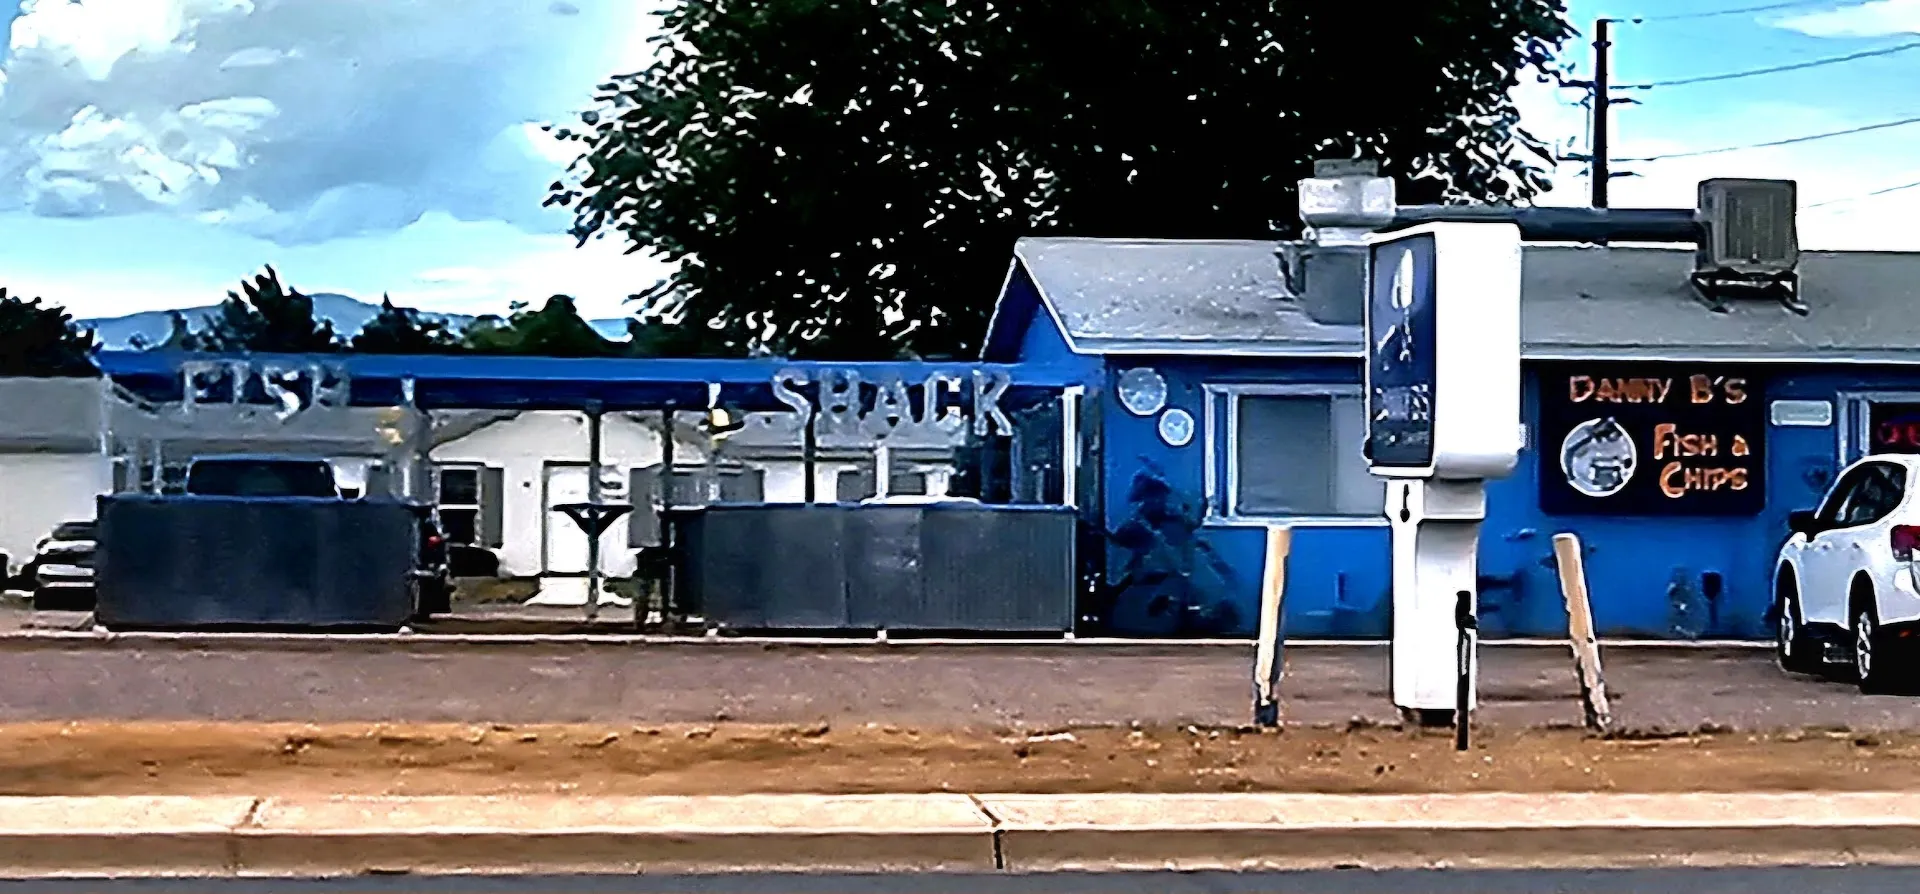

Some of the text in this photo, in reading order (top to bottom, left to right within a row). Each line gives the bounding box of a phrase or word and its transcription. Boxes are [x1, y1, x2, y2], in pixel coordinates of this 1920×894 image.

[182, 360, 1012, 436] FISH SHACK
[1569, 373, 1748, 404] DANNY B'S
[1653, 422, 1718, 460] FISH
[1658, 460, 1749, 499] CHIPS
